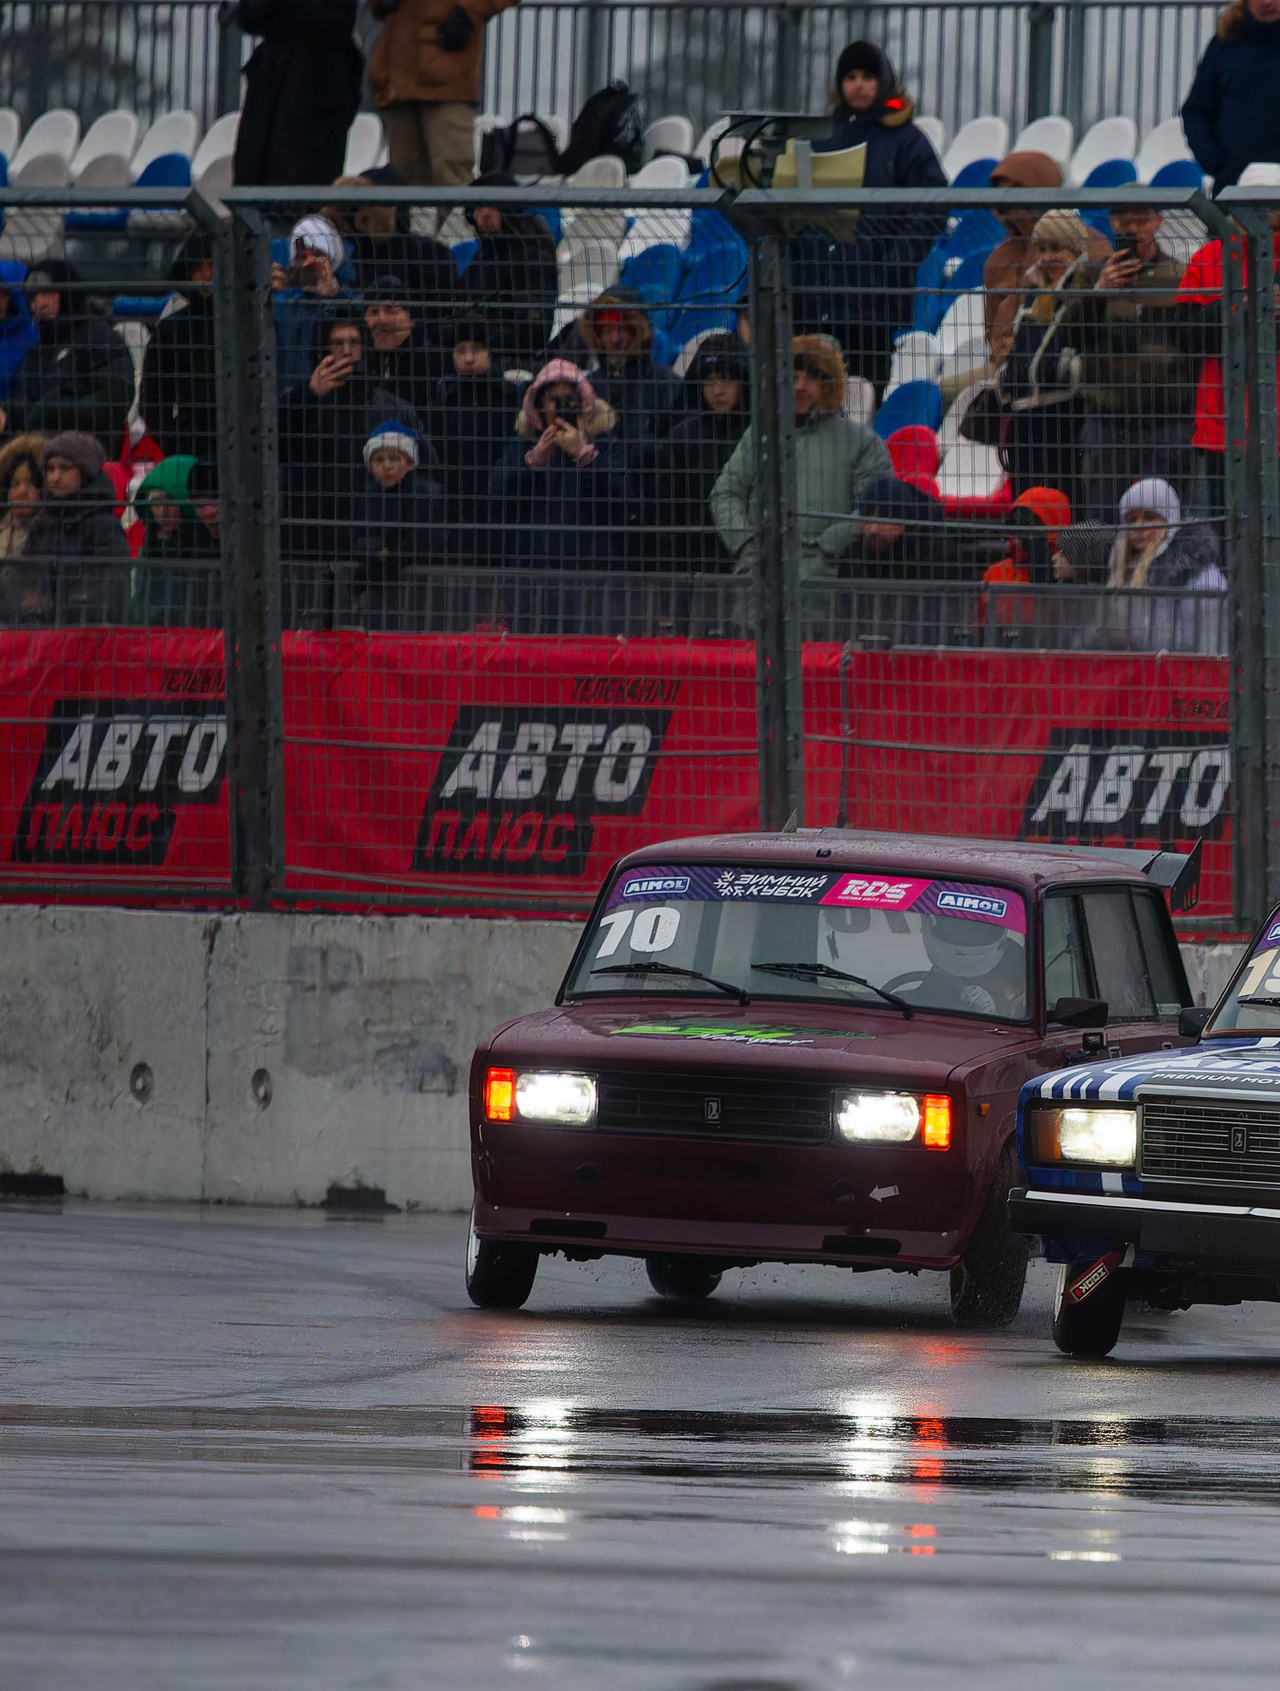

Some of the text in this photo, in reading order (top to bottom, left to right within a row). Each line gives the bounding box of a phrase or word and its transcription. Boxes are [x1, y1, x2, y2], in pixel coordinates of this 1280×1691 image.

[40, 713, 227, 792] АВТО
[439, 721, 652, 802] АВТО
[1030, 743, 1231, 827] АВТО
[26, 801, 158, 851] ПЛЮС
[424, 810, 576, 863] ПЛЮС
[627, 880, 686, 893] AIMOL
[735, 874, 828, 888] ЗИМНИЙ
[746, 885, 819, 898] КУБОК
[842, 879, 913, 899] RDS
[940, 895, 1003, 914] AIMOL
[596, 907, 680, 959] 70
[1152, 1073, 1240, 1083] PREMIUM
